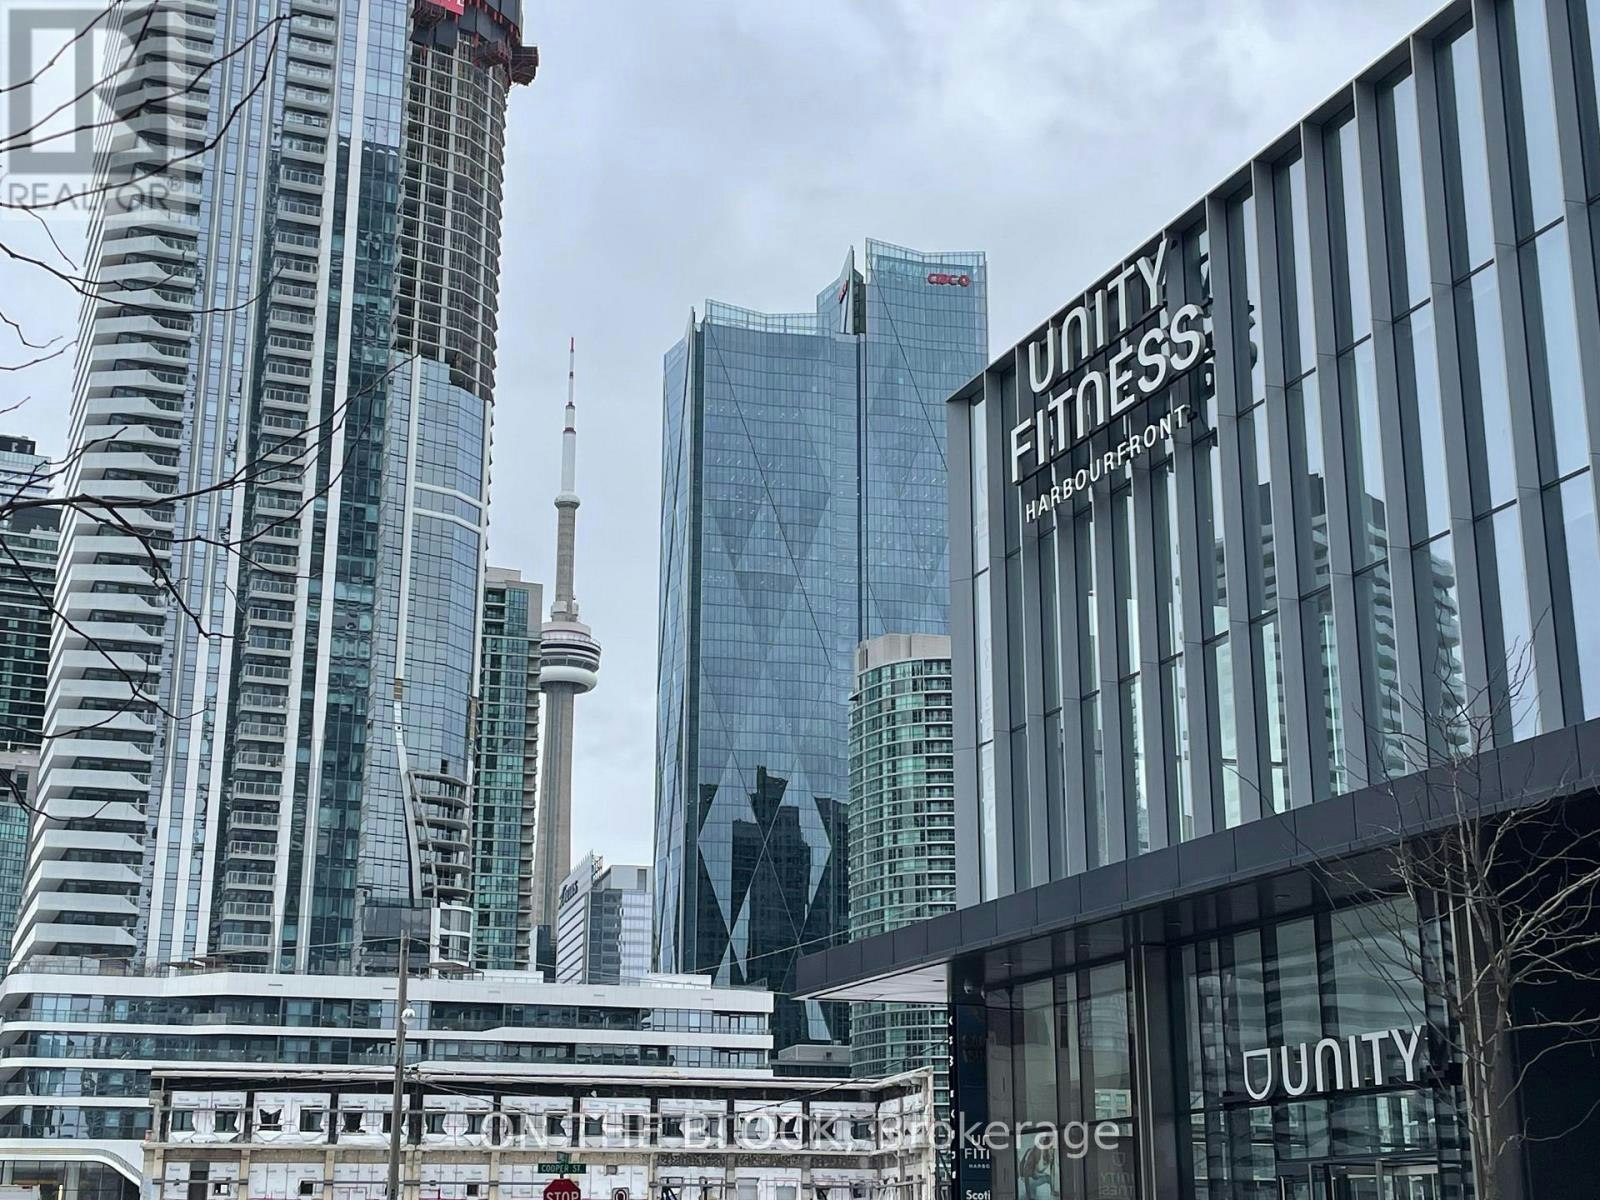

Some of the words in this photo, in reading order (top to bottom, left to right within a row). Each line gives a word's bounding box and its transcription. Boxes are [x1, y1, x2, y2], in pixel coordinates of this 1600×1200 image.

[1028, 238, 1168, 394] UNITY
[1010, 304, 1205, 485] FITNESS
[1026, 404, 1191, 523] HARBOURFRONT
[1281, 1025, 1422, 1096] UNITY
[541, 1164, 569, 1173] COOPER
